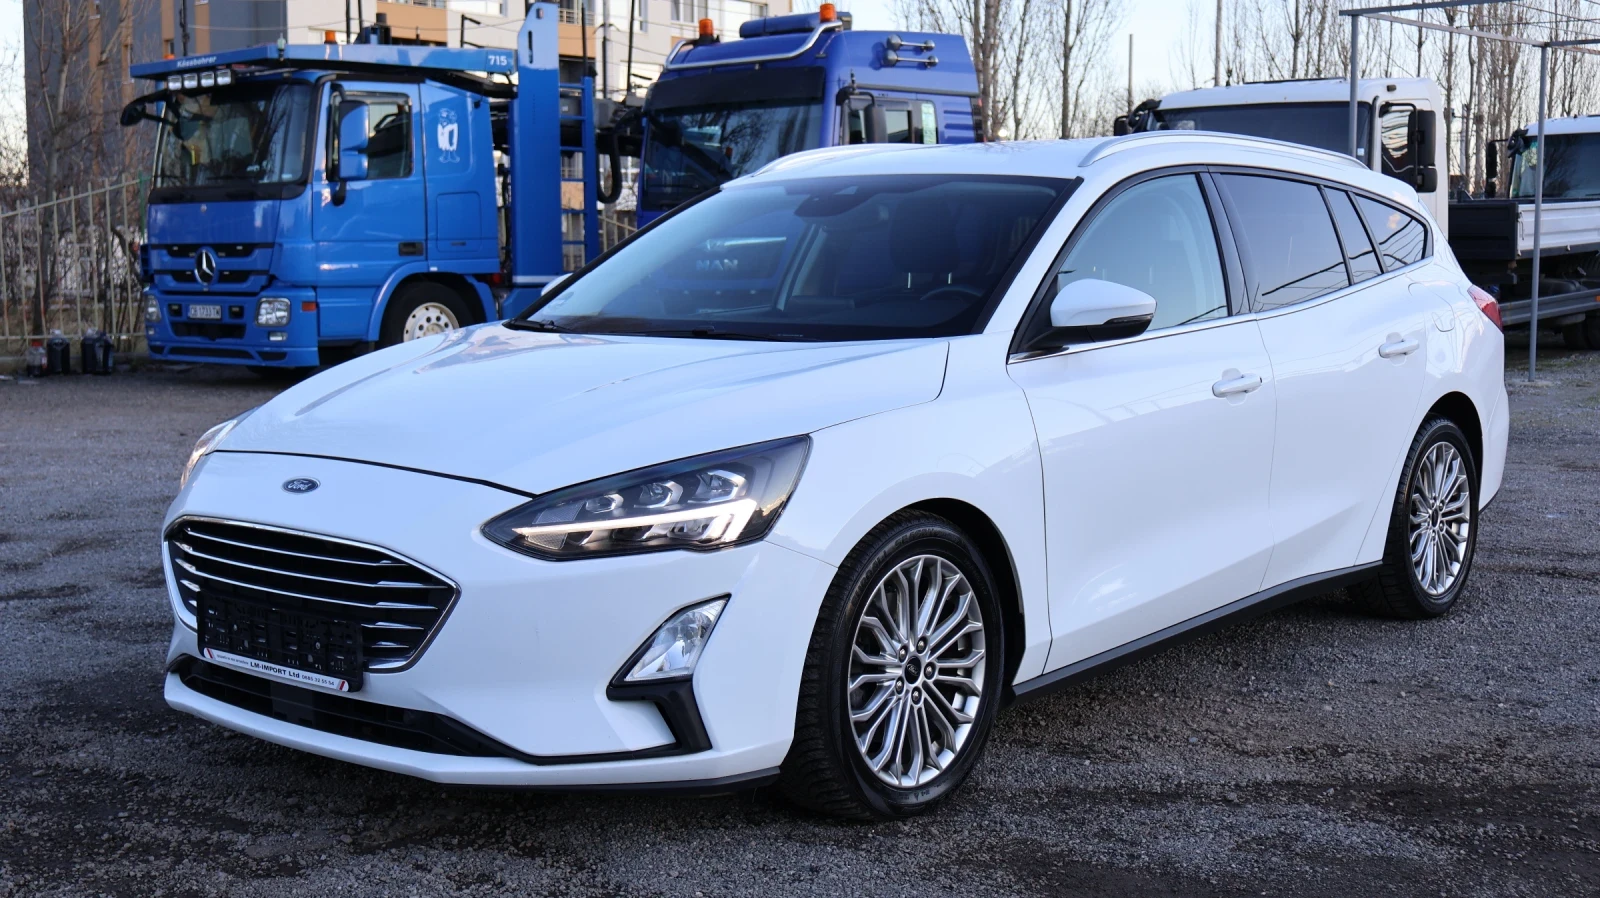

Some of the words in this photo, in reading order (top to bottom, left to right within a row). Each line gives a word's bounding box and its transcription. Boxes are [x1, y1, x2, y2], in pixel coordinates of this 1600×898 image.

[488, 55, 508, 66] 715
[696, 259, 738, 271] MAN
[287, 479, 312, 491] Ford
